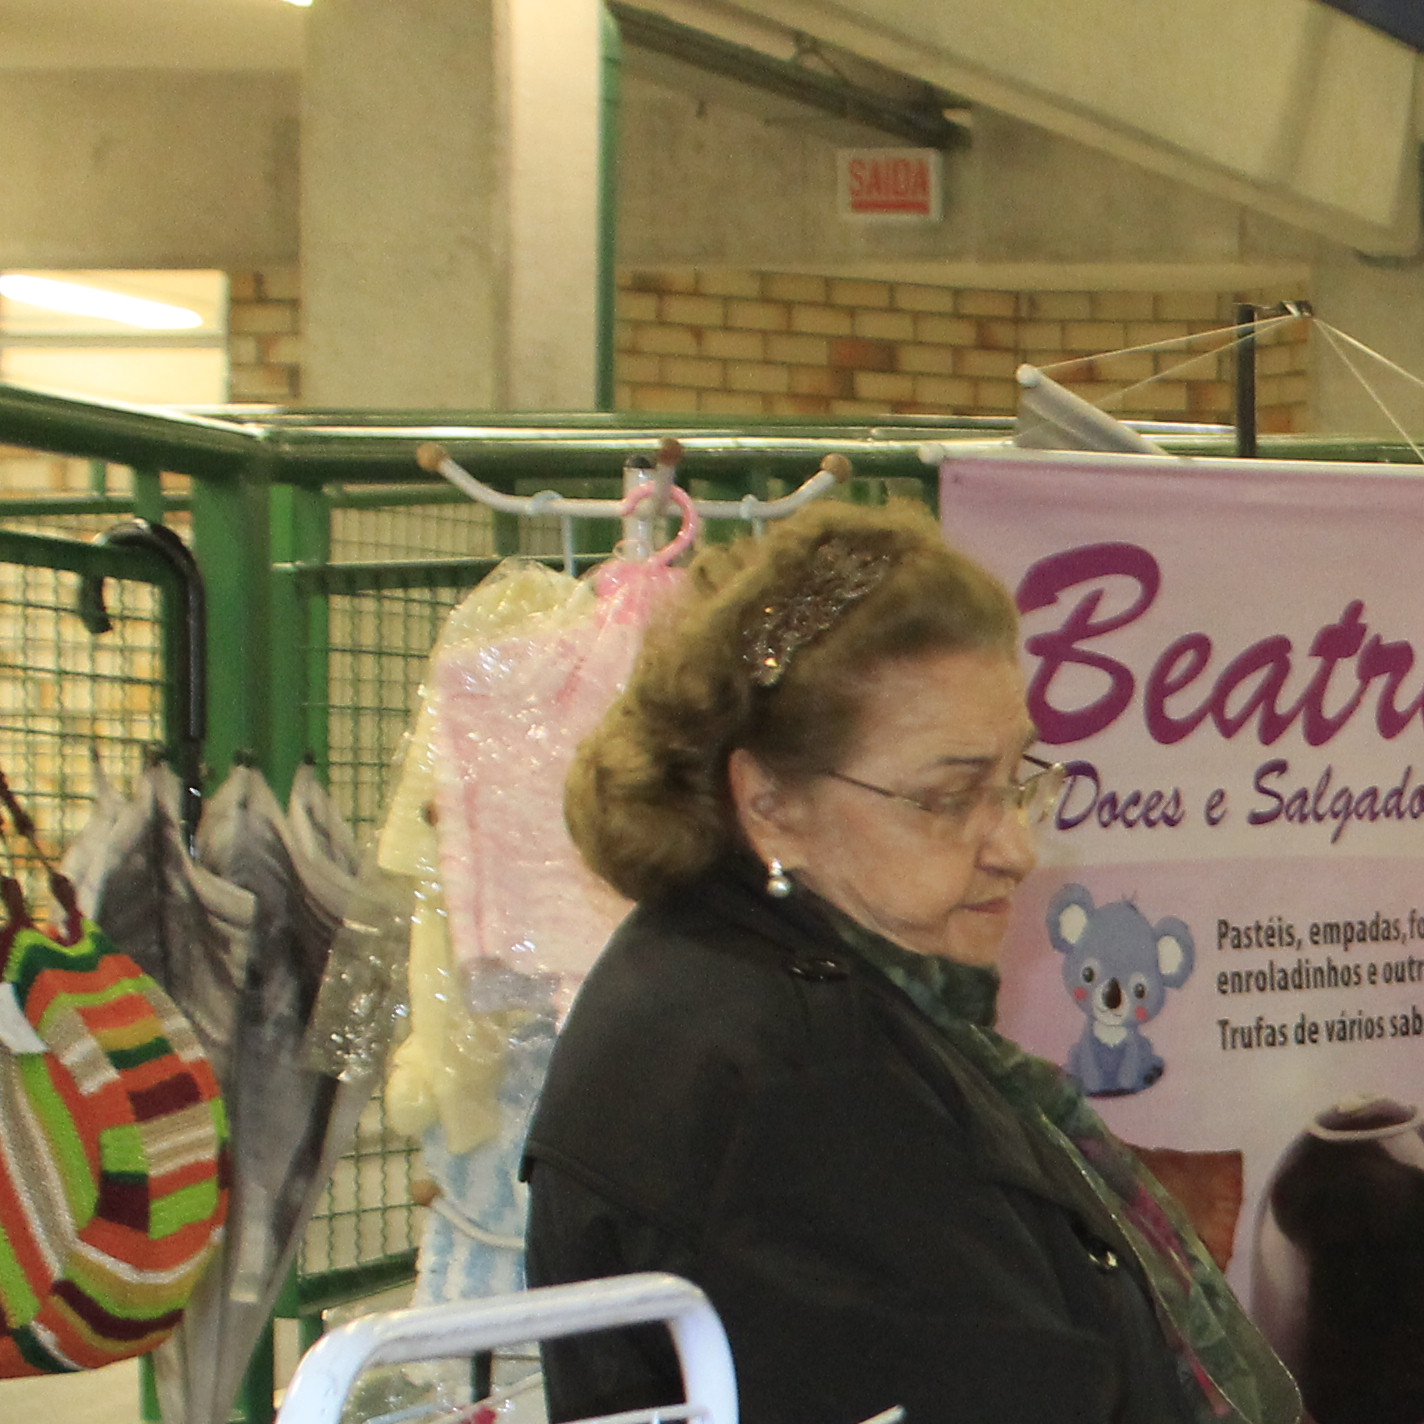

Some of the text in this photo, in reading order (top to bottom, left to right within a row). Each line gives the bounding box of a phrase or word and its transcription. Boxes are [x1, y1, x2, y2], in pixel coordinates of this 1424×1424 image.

[1055, 759, 1186, 831] Doces
[1204, 787, 1229, 827] e
[1216, 916, 1302, 951] Pastéis,
[1216, 956, 1362, 995] enroladinhos
[1366, 963, 1378, 986] e
[1216, 1015, 1288, 1051] Trufas
[1294, 1013, 1319, 1046] de
[1324, 1009, 1385, 1043] vários
